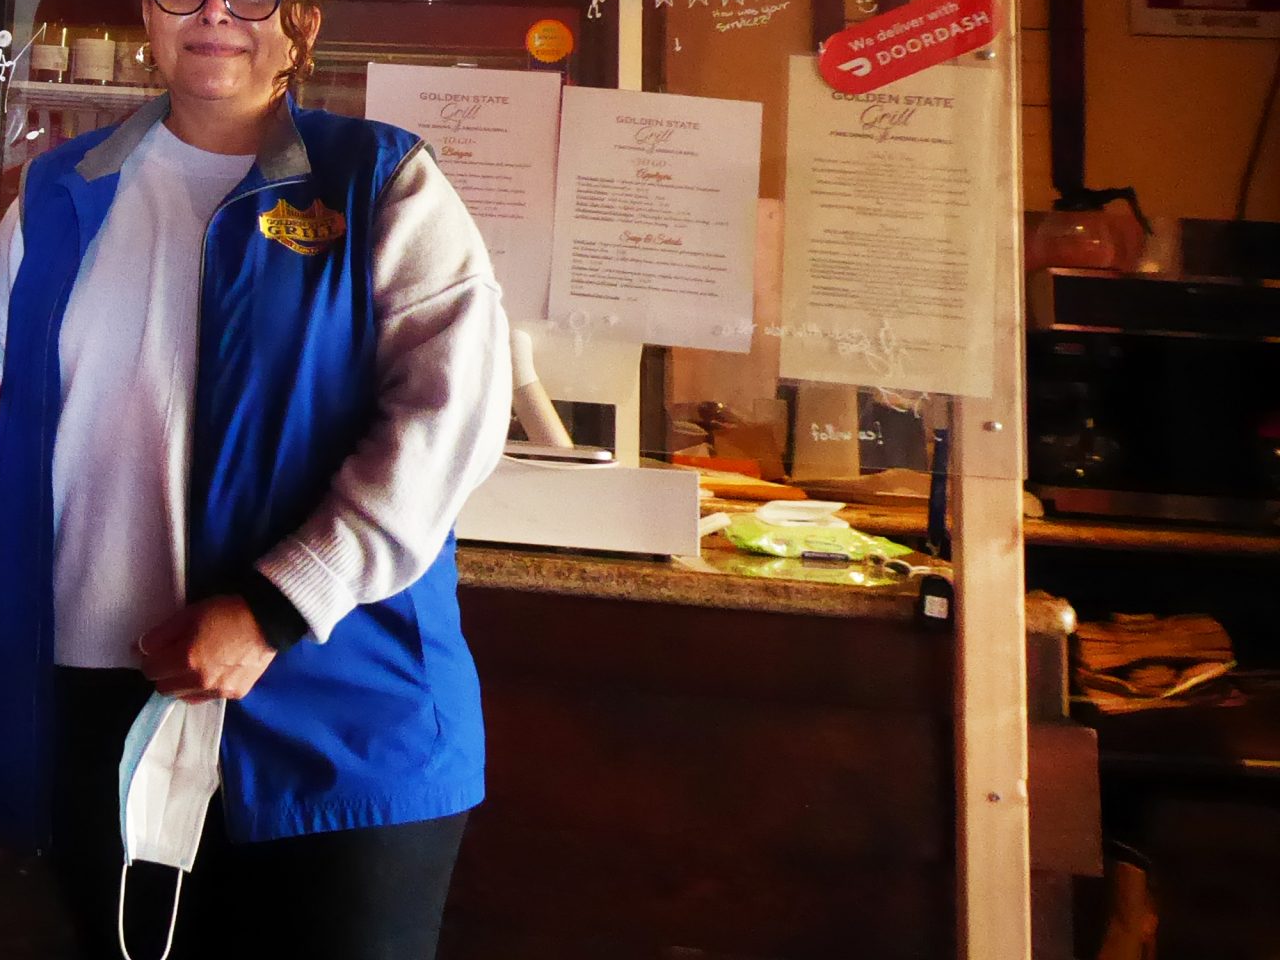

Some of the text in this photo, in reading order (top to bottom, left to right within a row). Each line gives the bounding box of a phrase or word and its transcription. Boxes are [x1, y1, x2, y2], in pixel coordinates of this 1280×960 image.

[848, 2, 959, 52] We deliver with
[876, 11, 991, 66] DOORDASH
[420, 92, 509, 105] GOLDEN STATE
[831, 91, 956, 109] GOLDEN STATE
[616, 115, 700, 130] GOLDEN STATE
[860, 104, 917, 131] Grill
